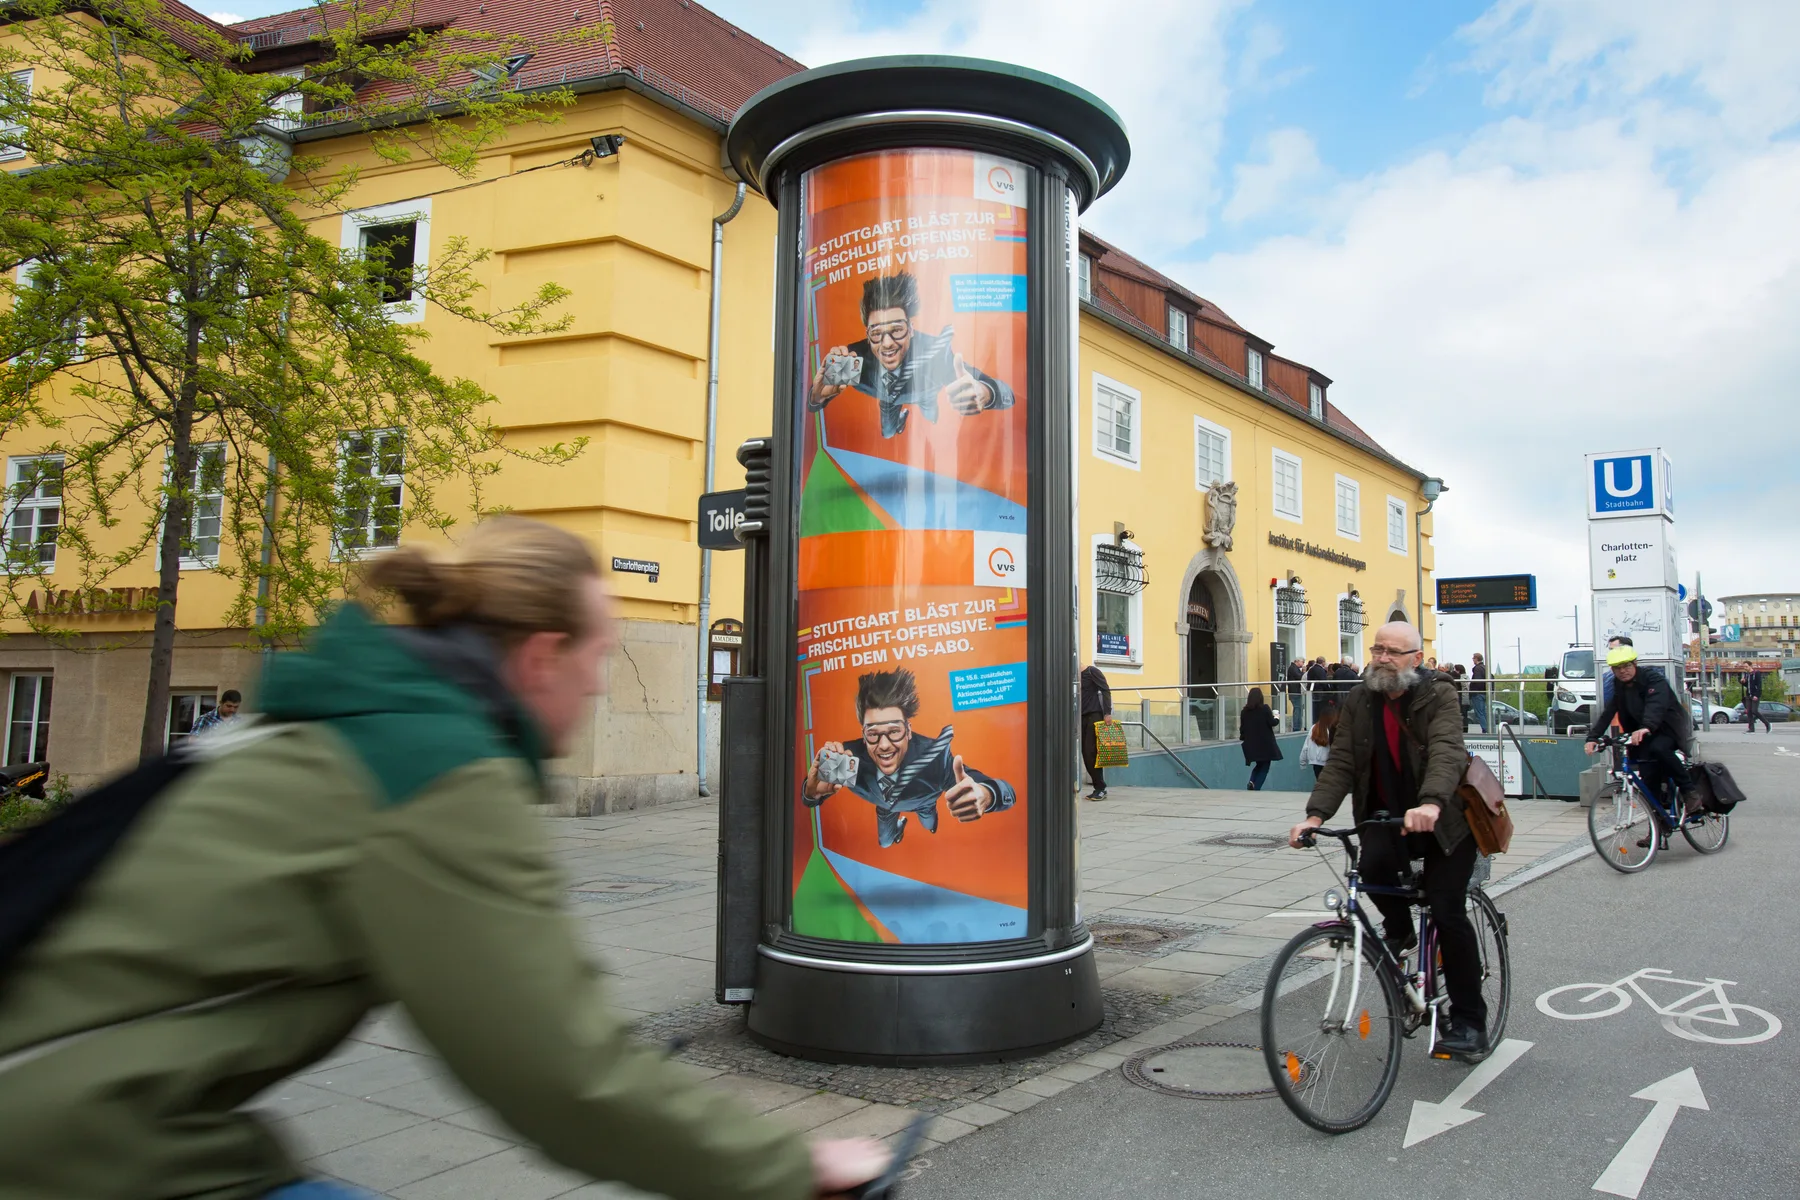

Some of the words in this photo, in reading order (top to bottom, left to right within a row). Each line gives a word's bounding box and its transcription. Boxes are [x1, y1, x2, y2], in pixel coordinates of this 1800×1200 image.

[996, 181, 1015, 192] VVS
[819, 219, 902, 256] STUTTGART
[907, 210, 959, 230] BLÄST
[964, 211, 995, 225] ZUR
[813, 228, 991, 275] FRISCHLUFT-OFFENSIVE.
[828, 265, 852, 285] MIT
[857, 255, 891, 275] DEM
[895, 245, 974, 265] VVS-ABO.
[1604, 459, 1642, 498] U
[1605, 500, 1644, 508] Stadtbahn
[1268, 531, 1294, 551] Institut
[1294, 537, 1305, 553] für
[1601, 542, 1654, 552] Charlotten-
[614, 558, 659, 574] Charlottenplatz
[1615, 554, 1637, 564] platz
[997, 563, 1016, 572] VVS
[813, 610, 899, 639] STUTTGART
[904, 602, 959, 622] BLÄST
[964, 599, 996, 614] ZUR
[808, 618, 992, 658] FRISCHLUFT-OFFENSIVE.
[823, 655, 847, 672] MIT
[851, 649, 888, 667] DEM
[892, 638, 974, 660] VVS-ABO.
[956, 681, 985, 690] Freimonat
[957, 689, 993, 698] Aktionscode
[958, 694, 1003, 706] vvs.de/frischluft
[999, 920, 1016, 928] vvs.de
